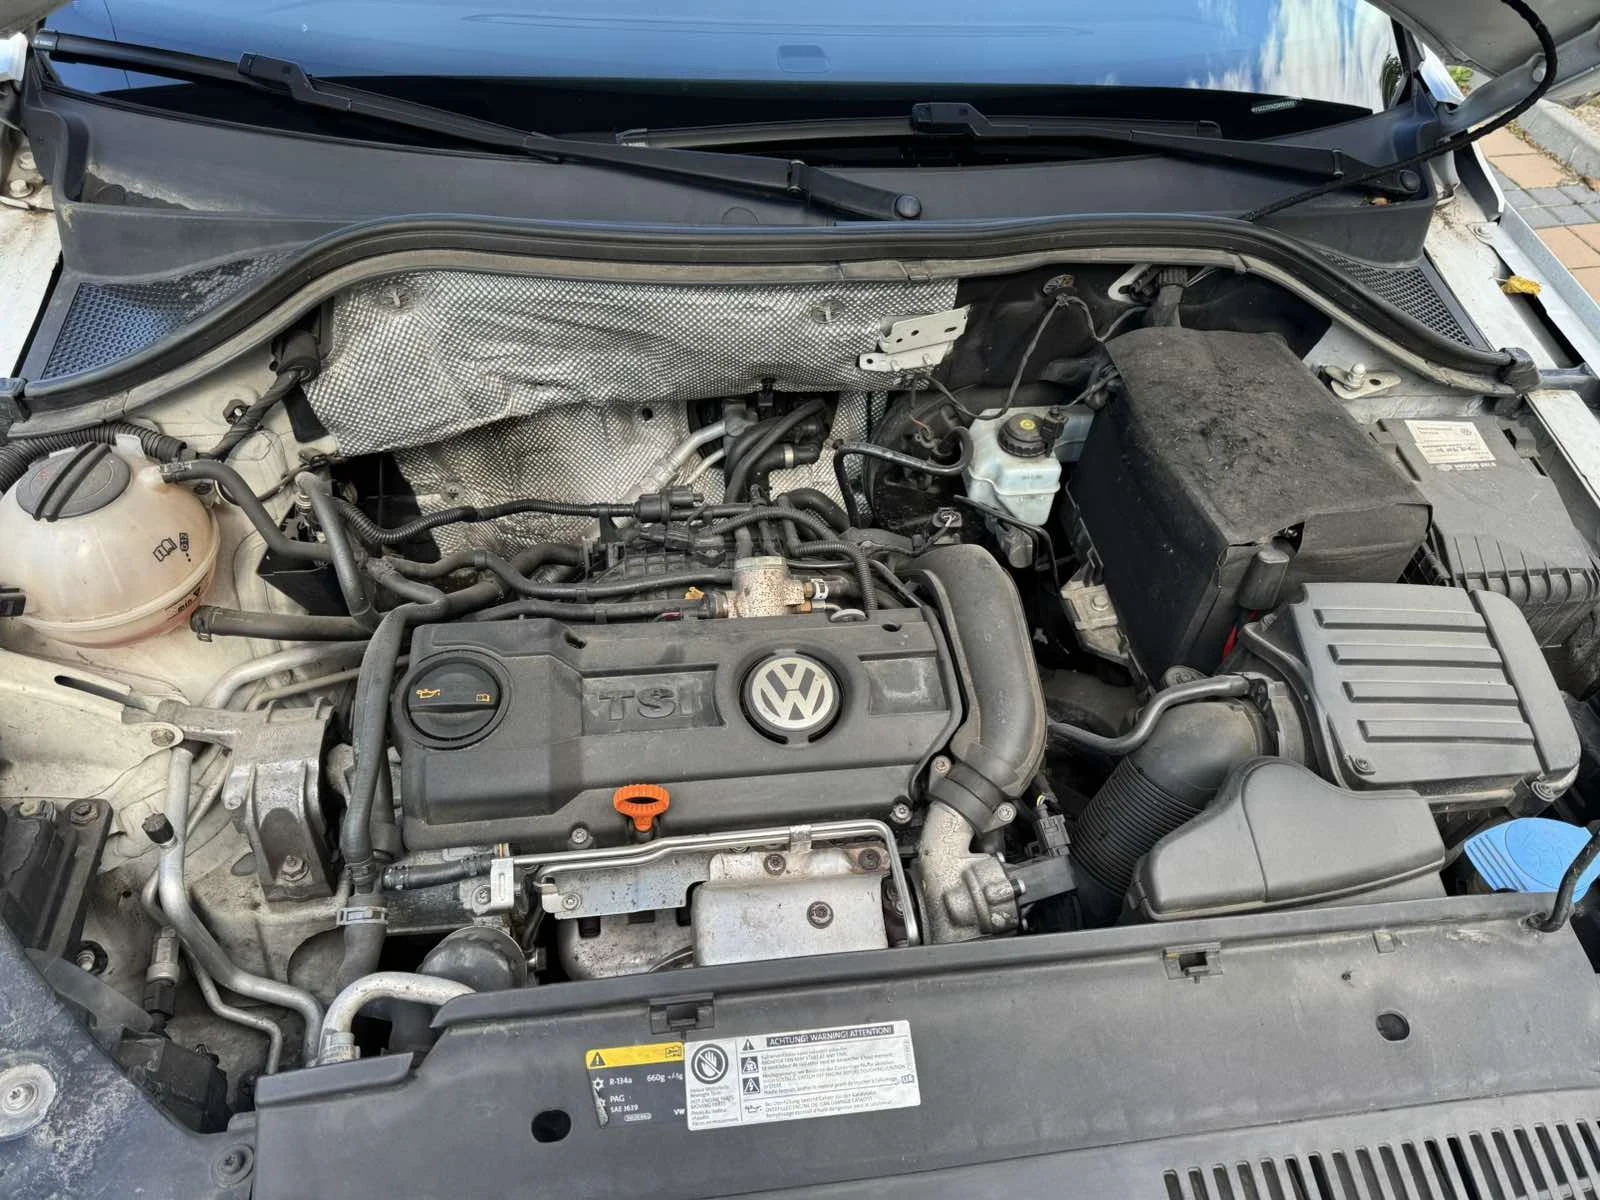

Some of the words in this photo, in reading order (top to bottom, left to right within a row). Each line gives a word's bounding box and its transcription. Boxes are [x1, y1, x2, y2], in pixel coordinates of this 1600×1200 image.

[599, 687, 697, 721] TSI
[769, 1034, 809, 1046] ACHTUNG!
[810, 1030, 849, 1042] WARNING!
[849, 1026, 892, 1038] ATTENTION!
[609, 1076, 633, 1086] R-134a
[646, 1073, 666, 1083] 660g
[609, 1094, 625, 1103] PAG
[610, 1105, 622, 1113] SAE
